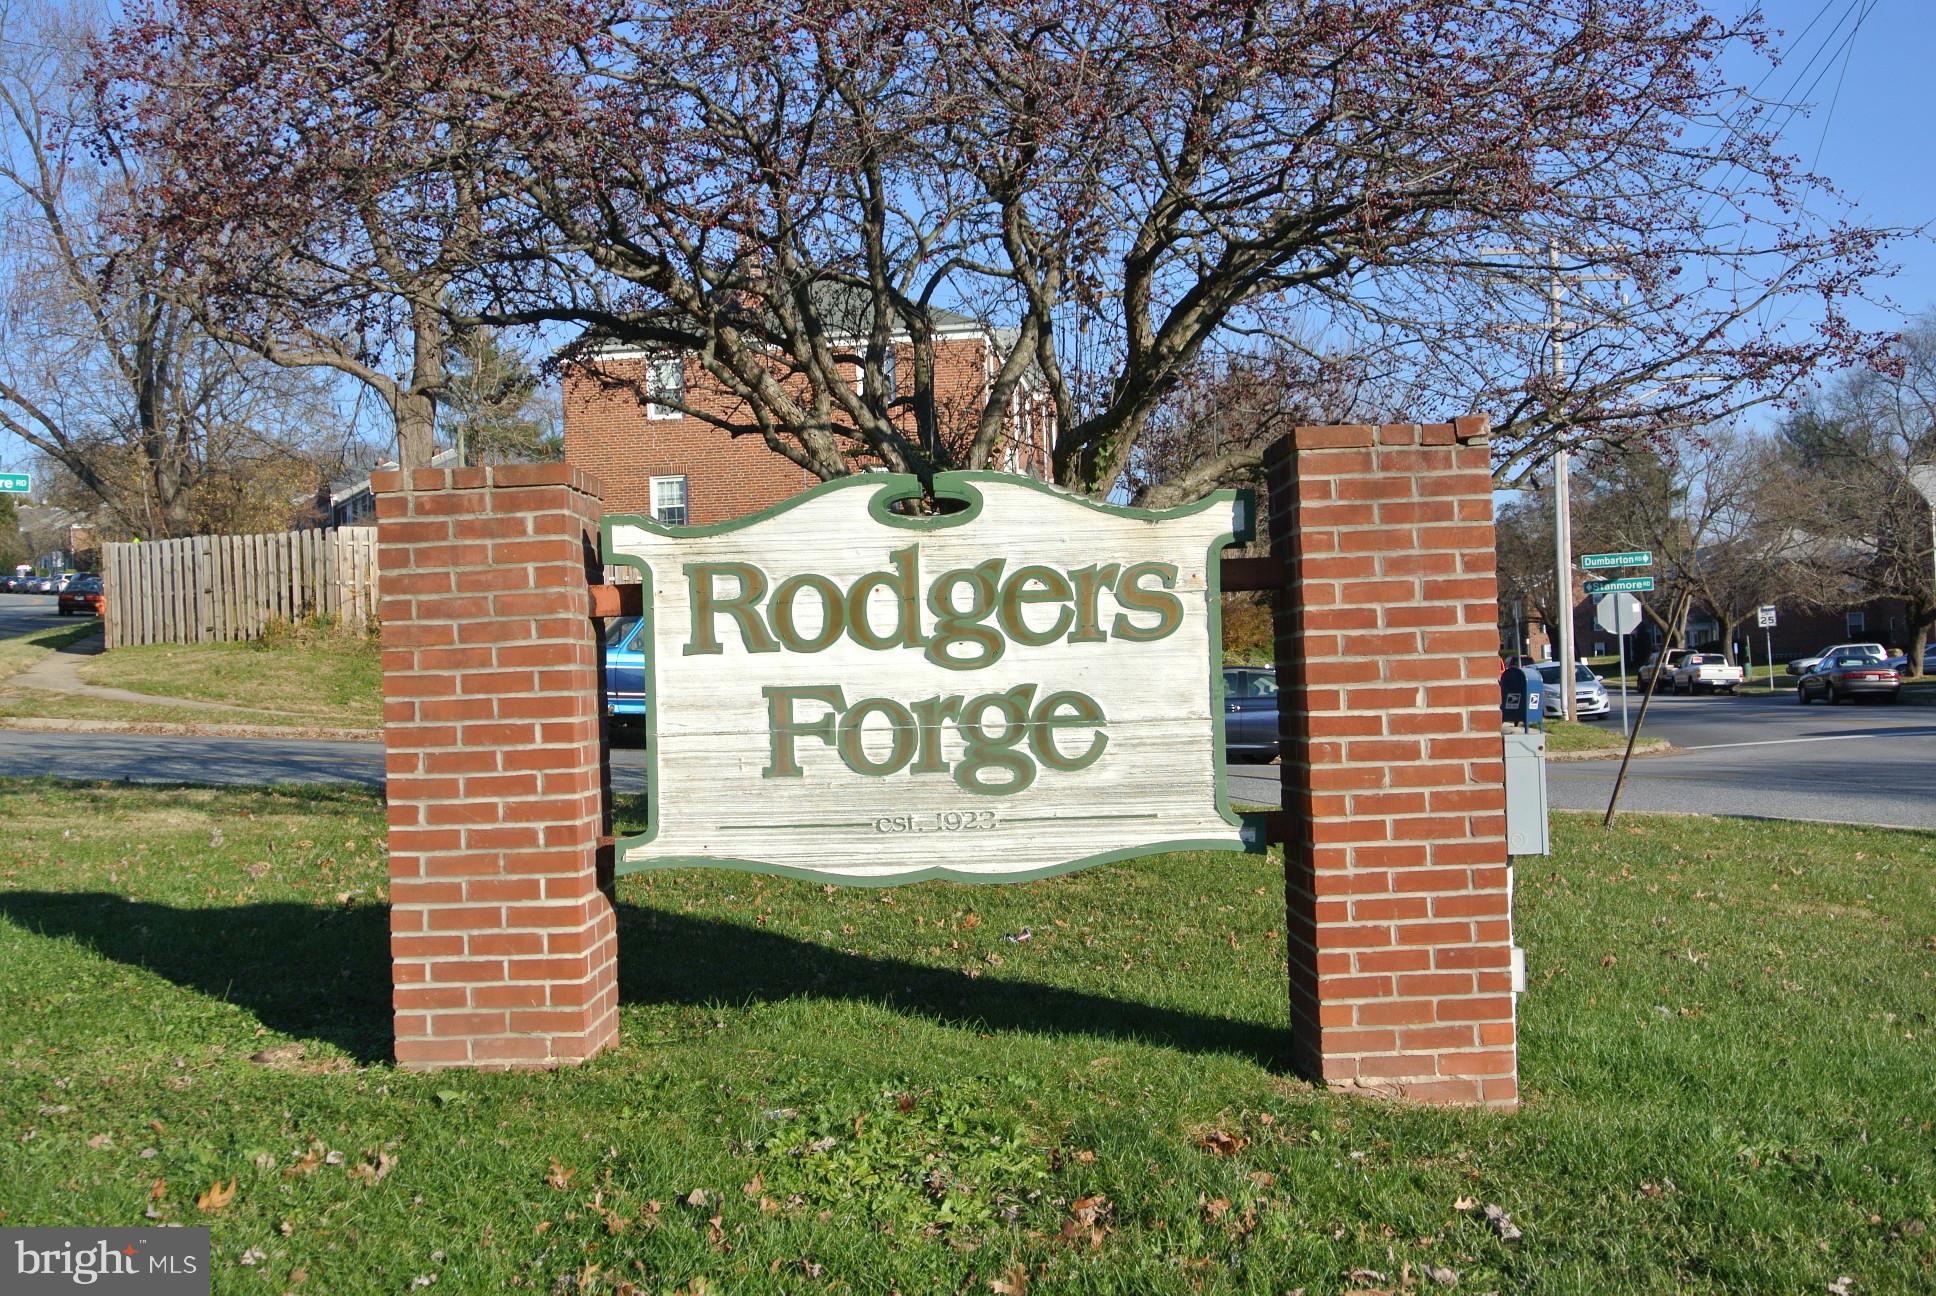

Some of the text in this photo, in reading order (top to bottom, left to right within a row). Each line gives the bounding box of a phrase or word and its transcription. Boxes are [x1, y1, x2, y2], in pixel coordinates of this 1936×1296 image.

[1584, 555, 1634, 566] Dumbarton
[1592, 581, 1642, 591] Stanmore
[682, 542, 1184, 671] Rodgers
[1760, 616, 1774, 624] 25
[761, 683, 1108, 796] Forge
[875, 811, 996, 833] est. 1923
